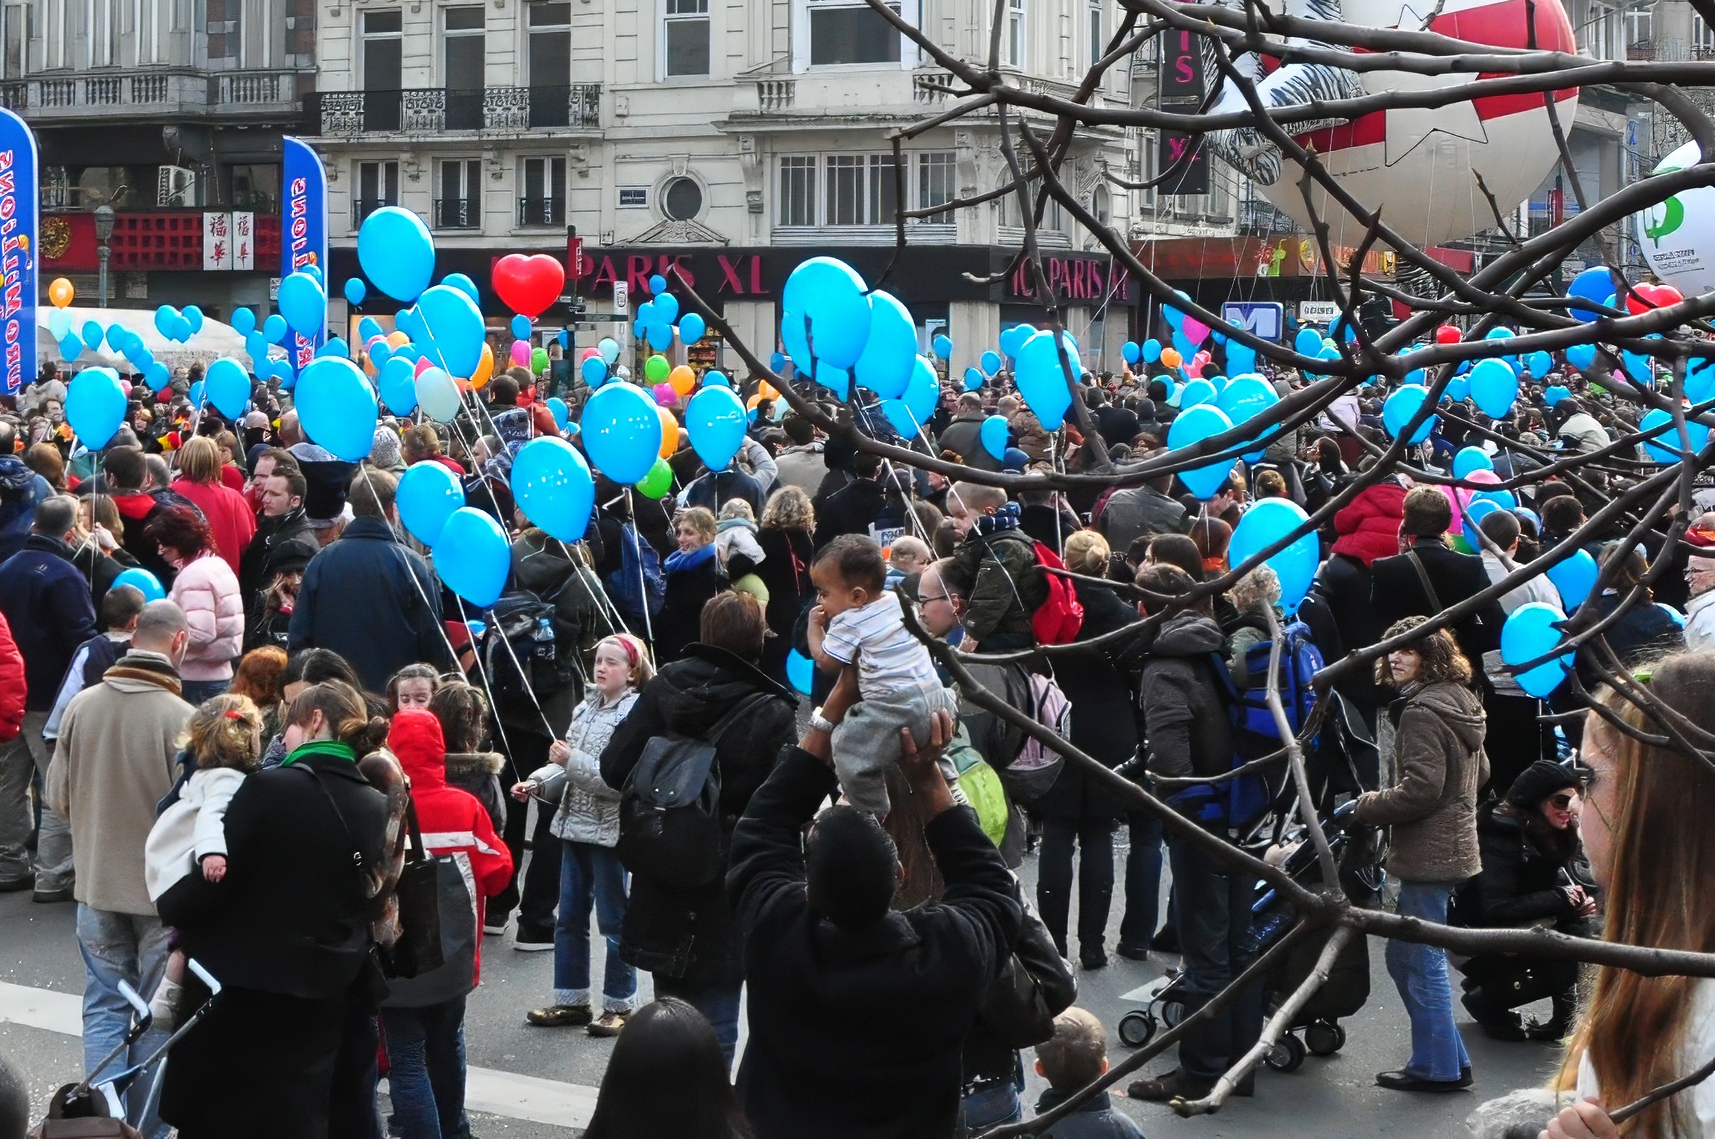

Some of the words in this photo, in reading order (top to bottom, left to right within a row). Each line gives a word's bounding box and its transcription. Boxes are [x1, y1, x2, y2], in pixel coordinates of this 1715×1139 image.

[717, 254, 771, 295] XL
[1012, 256, 1042, 299] IC
[1049, 257, 1103, 299] PARIS
